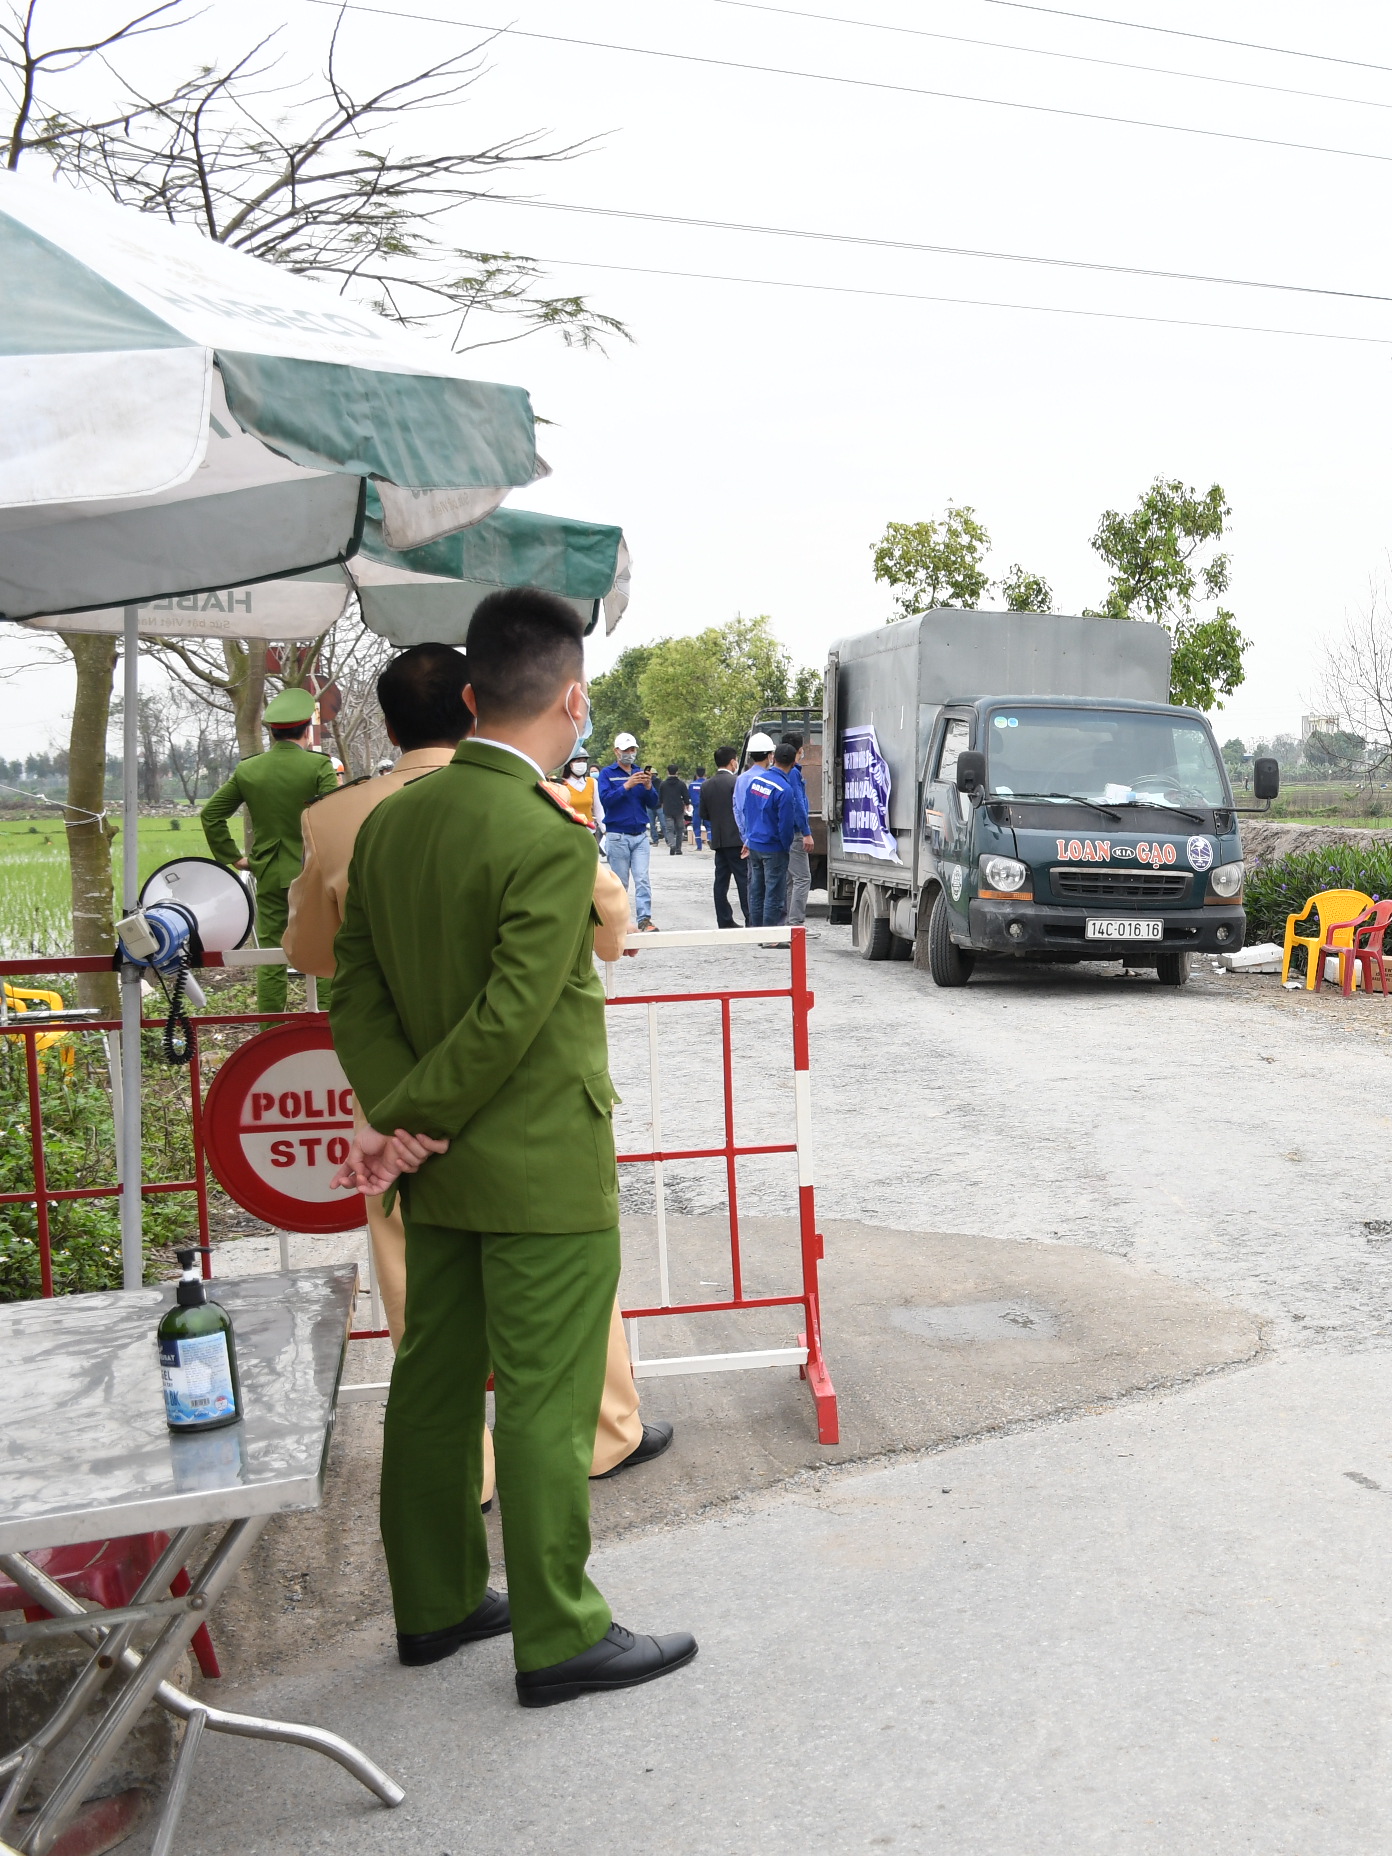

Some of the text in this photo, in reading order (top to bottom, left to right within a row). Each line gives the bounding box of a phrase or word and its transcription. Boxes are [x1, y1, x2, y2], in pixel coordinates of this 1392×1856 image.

[134, 280, 385, 341] HABECO
[1056, 839, 1177, 869] LOAN KIA GẠO
[1092, 922, 1160, 937] 14C-016.16
[252, 1088, 353, 1121] POLIC
[270, 1136, 350, 1168] STO
